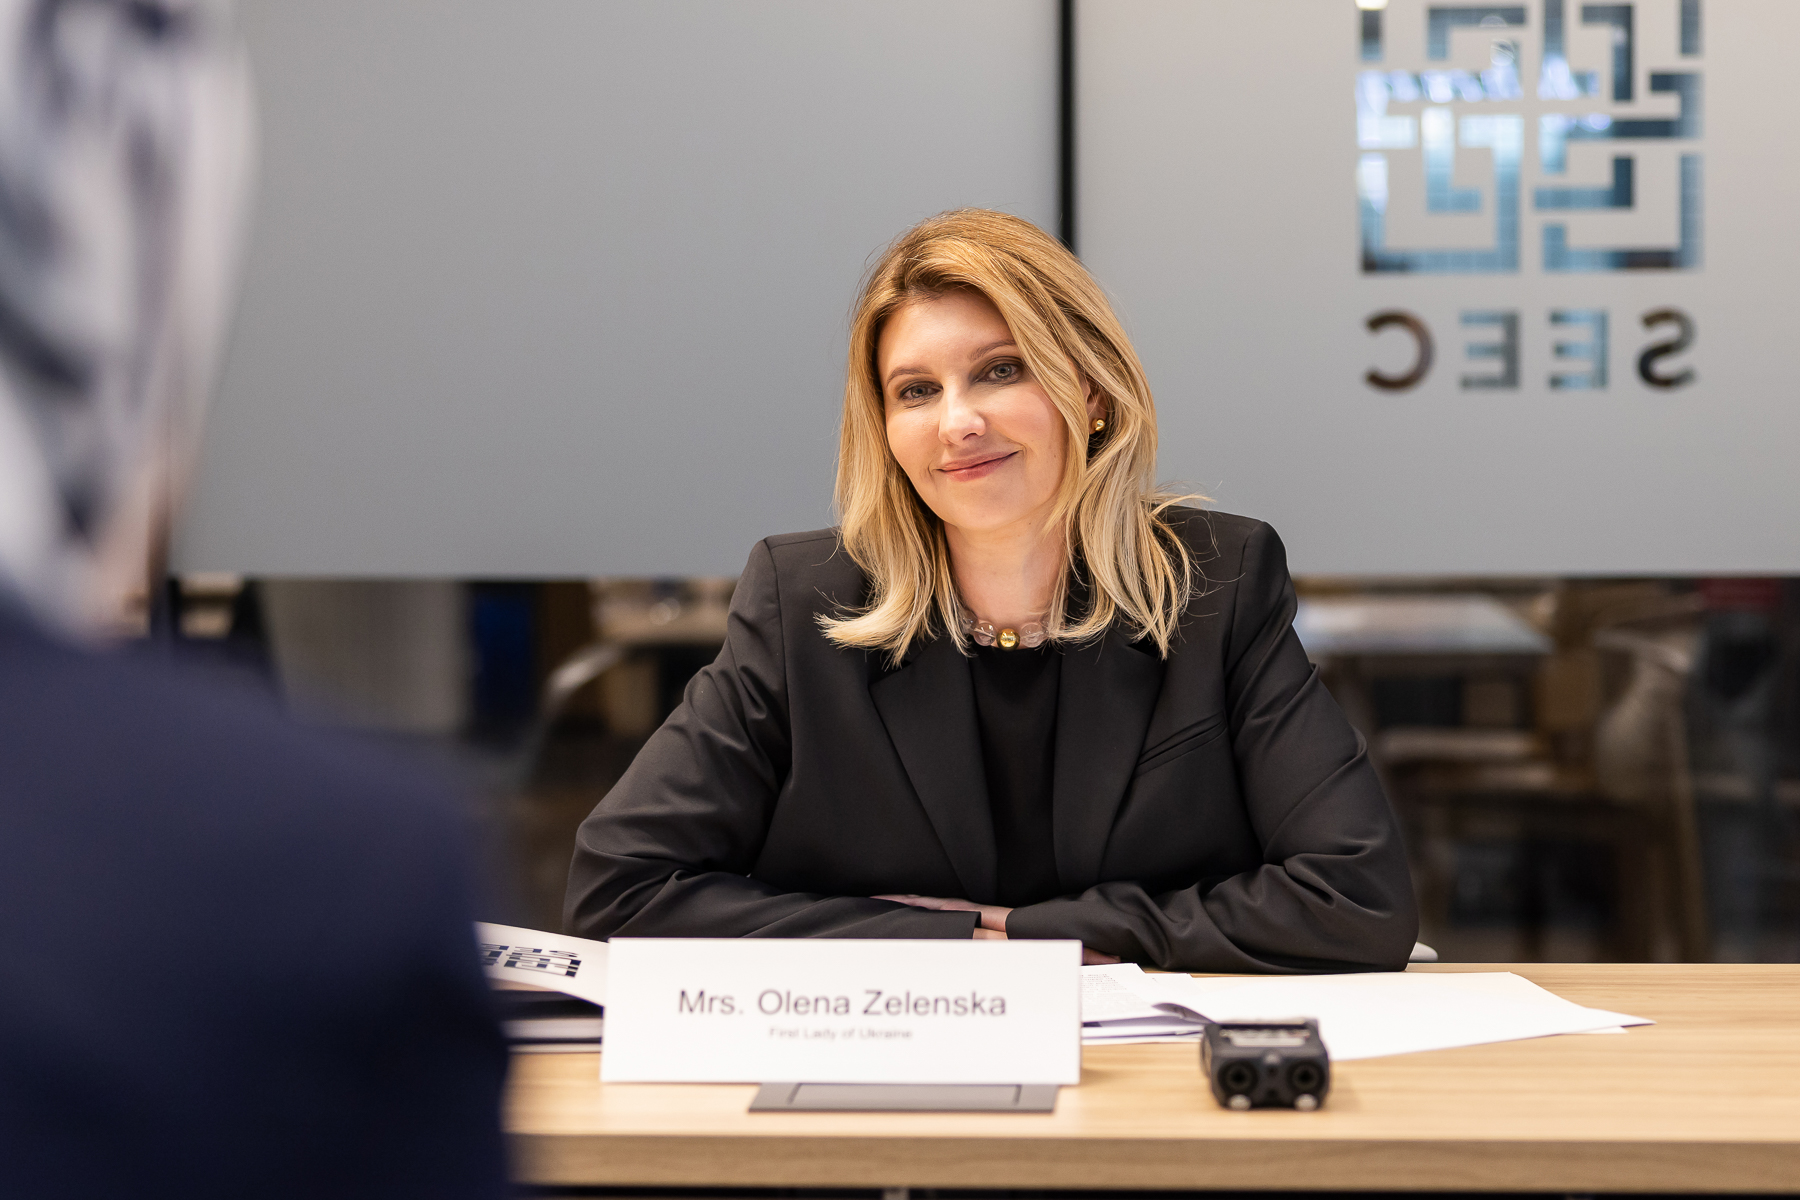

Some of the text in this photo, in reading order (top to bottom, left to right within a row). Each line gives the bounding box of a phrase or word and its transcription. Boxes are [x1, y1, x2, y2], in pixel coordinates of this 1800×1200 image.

[678, 989, 1007, 1016] Mrs. Olena Zelenska
[769, 1027, 913, 1043] First Lady of Ukraine
